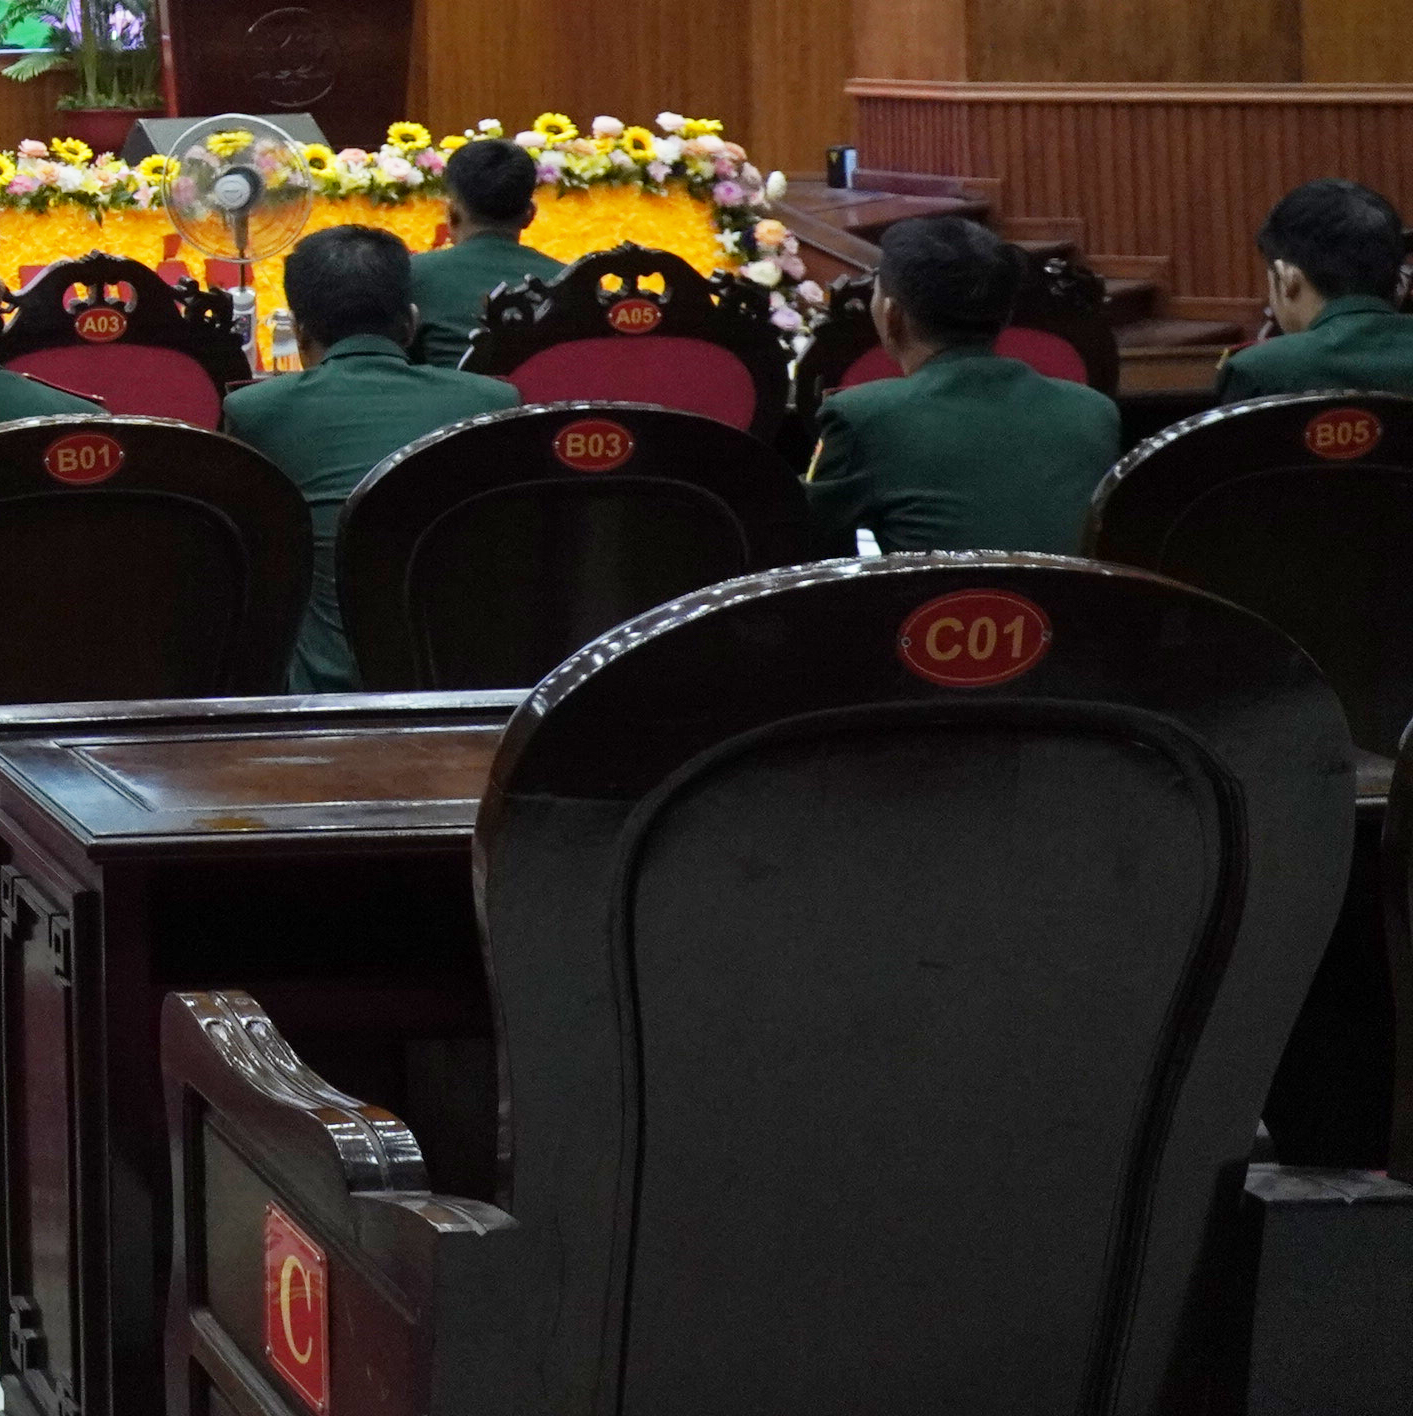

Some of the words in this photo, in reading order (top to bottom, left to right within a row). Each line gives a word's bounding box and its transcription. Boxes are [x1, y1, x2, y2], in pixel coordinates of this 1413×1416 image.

[81, 315, 120, 333] A03
[615, 307, 654, 325] A05
[566, 433, 622, 457] B03
[1314, 420, 1371, 448] B05
[58, 445, 111, 472] B01
[926, 615, 1028, 660] C01
[280, 1255, 313, 1364] C
